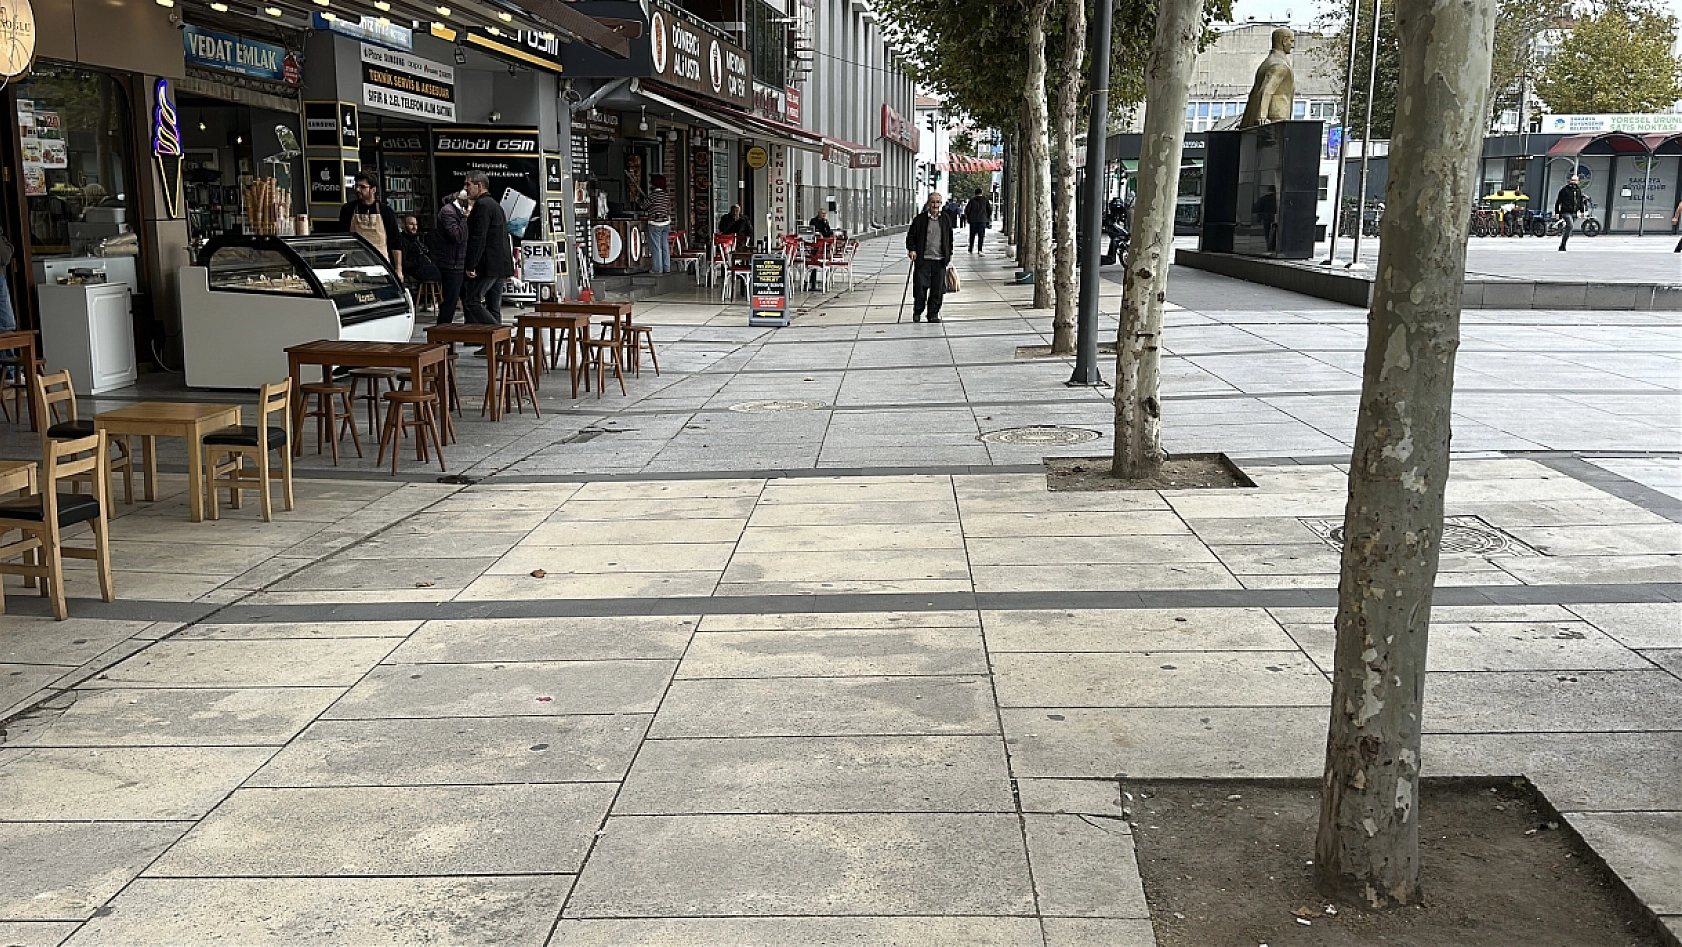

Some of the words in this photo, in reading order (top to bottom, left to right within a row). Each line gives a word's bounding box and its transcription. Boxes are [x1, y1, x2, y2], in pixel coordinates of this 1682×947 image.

[188, 33, 232, 62] VEDAT
[236, 42, 278, 71] EMLAK
[368, 68, 393, 86] TEKNİK
[393, 75, 415, 91] SERVİS
[1610, 116, 1651, 124] YÖRESEL
[438, 137, 491, 150] Bülbül
[496, 139, 535, 151] GSM
[312, 181, 340, 191] iPhone
[523, 245, 552, 258] ŞEN
